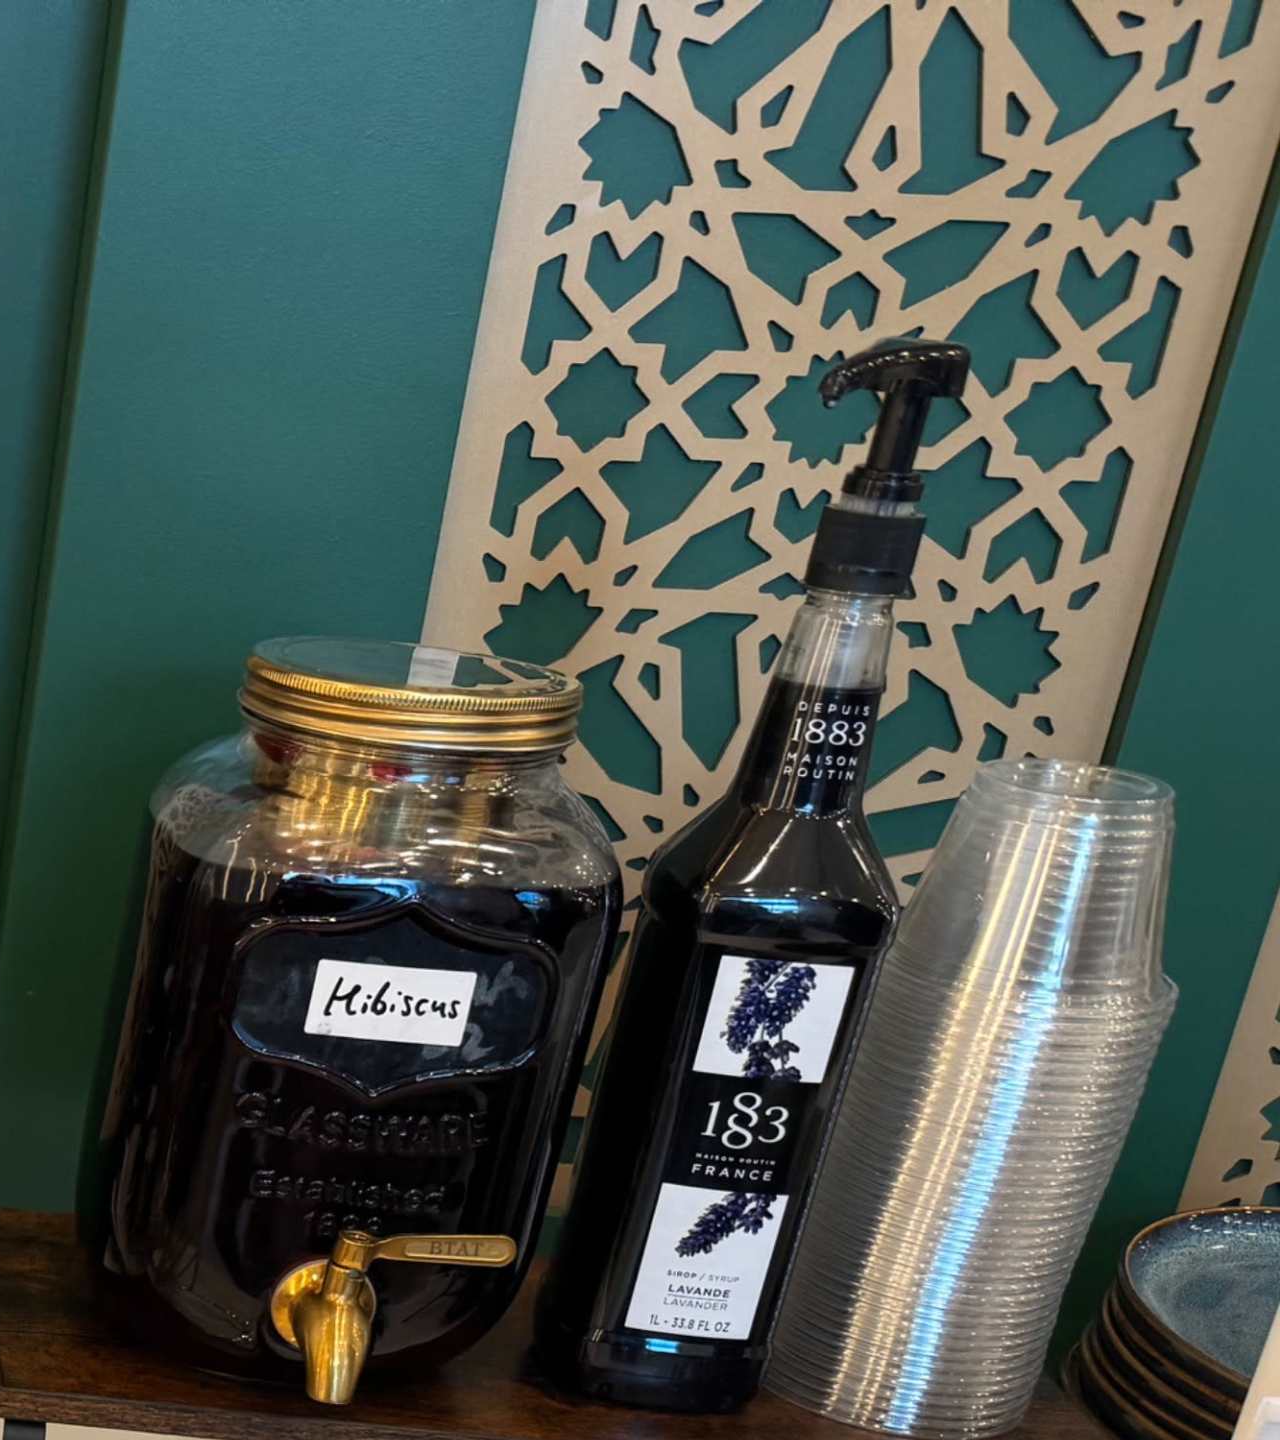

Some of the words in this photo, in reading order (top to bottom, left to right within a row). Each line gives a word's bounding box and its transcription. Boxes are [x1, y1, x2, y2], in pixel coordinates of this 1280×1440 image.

[798, 701, 870, 716] DEPUIS
[791, 718, 867, 746] 1883
[786, 752, 858, 767] MAISON
[783, 765, 855, 781] ROUTIN
[323, 976, 461, 1019] Hibiscus
[695, 1152, 735, 1162] MAISON
[691, 1163, 774, 1181] FRANCE
[667, 1269, 697, 1279] SIROP
[708, 1274, 740, 1283] SYRUP
[668, 1284, 731, 1299] LAVANDE
[663, 1297, 728, 1311] LAVANDER
[649, 1314, 660, 1326] 1L
[671, 1317, 695, 1330] 33.8
[697, 1319, 711, 1332] FL
[714, 1321, 731, 1333] OZ
